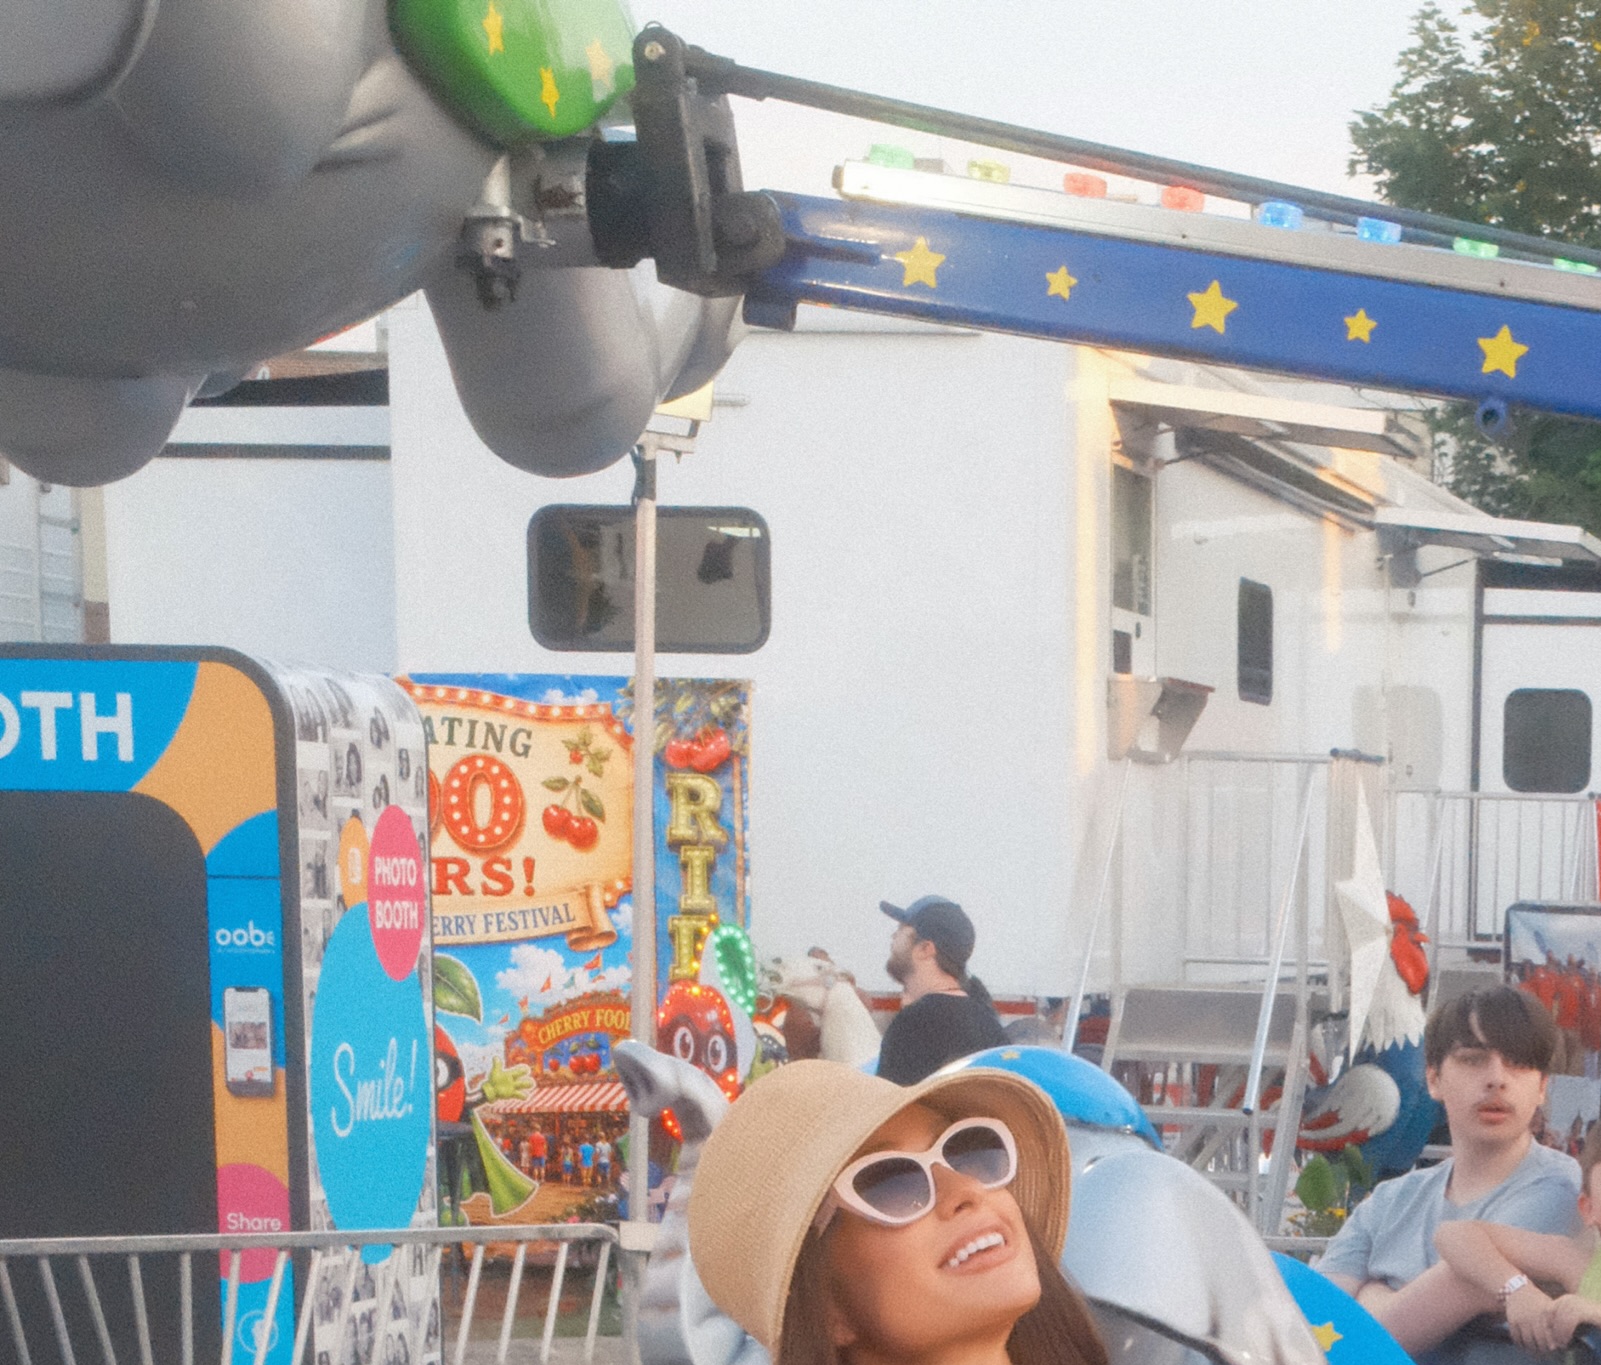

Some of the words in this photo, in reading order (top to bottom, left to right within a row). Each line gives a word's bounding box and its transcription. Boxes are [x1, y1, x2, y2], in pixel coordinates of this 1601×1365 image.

[374, 856, 417, 887] PHOTO
[375, 901, 418, 930] BOOTH
[483, 902, 577, 934] FESTIVAL
[538, 1011, 590, 1045] CHERRY
[331, 1037, 418, 1138] Smile!
[226, 1211, 282, 1231] Share
